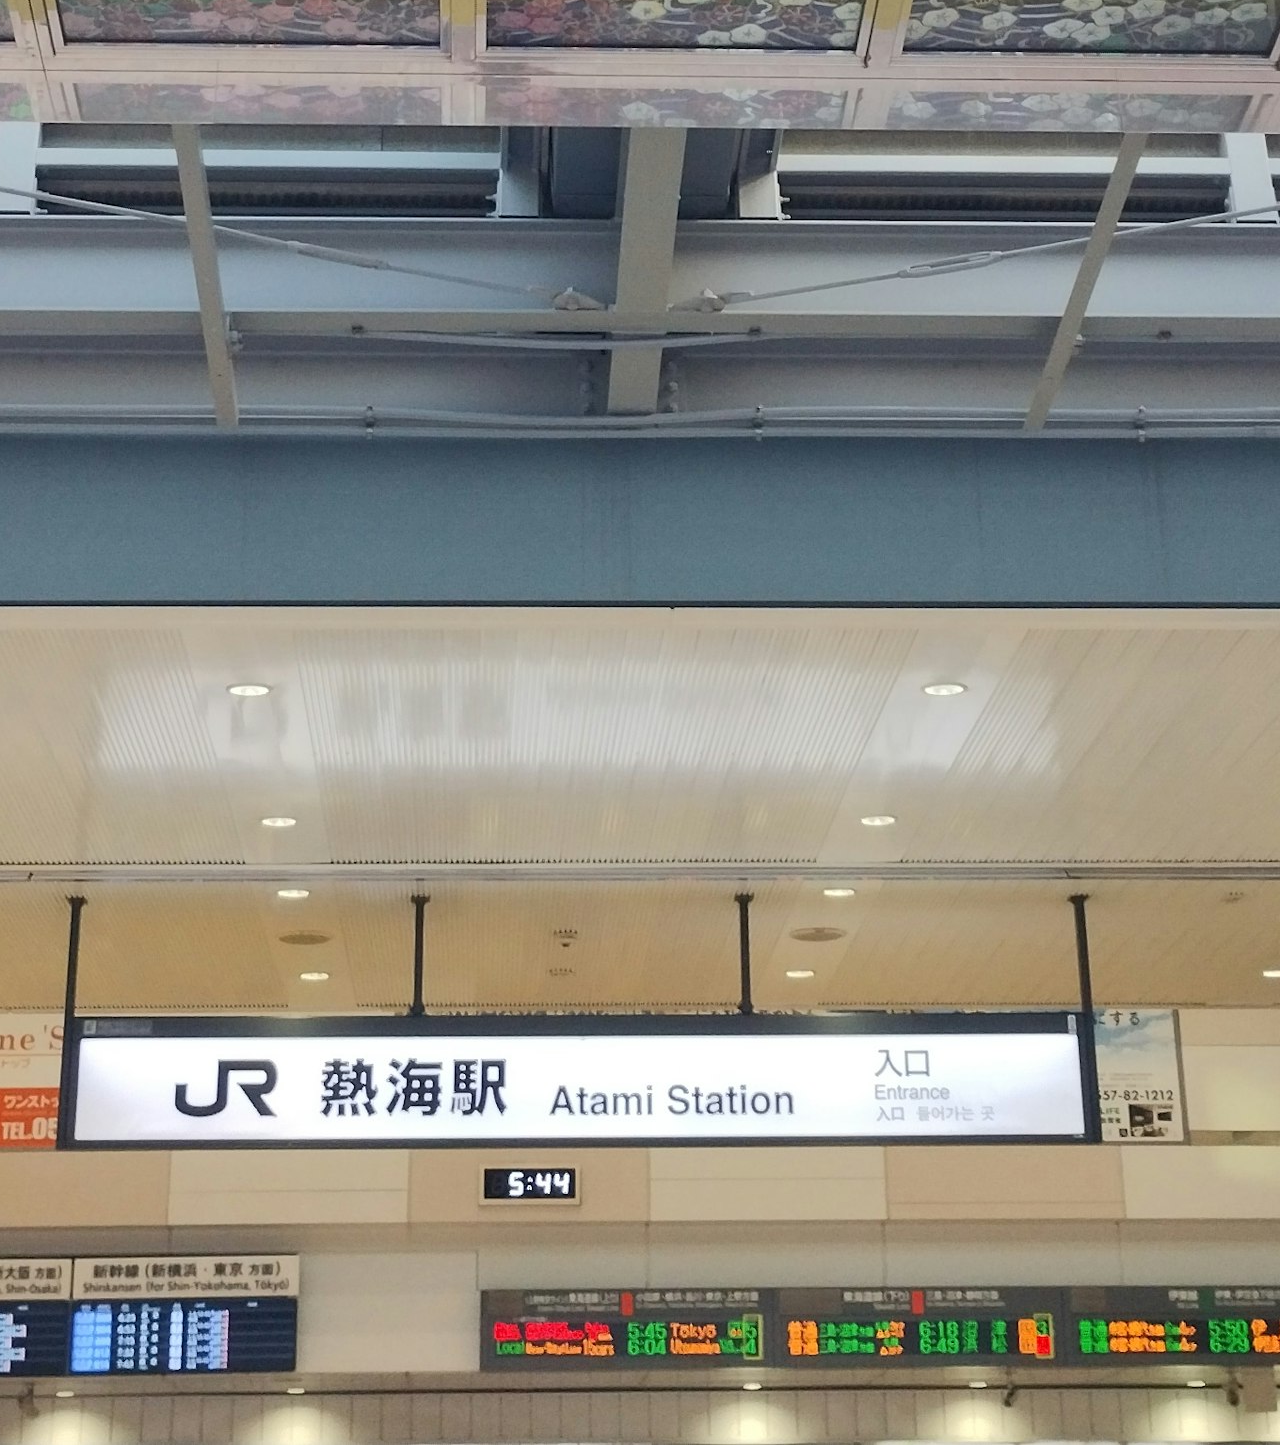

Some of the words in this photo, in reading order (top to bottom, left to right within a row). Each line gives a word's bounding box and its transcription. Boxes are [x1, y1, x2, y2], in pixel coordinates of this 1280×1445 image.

[874, 1049, 930, 1077] 入口
[174, 1059, 278, 1117] JR
[320, 1057, 507, 1117] 熱海駅
[549, 1085, 654, 1116] Atami
[666, 1085, 796, 1116] Station
[874, 1084, 951, 1101] Entrance
[1098, 1089, 1174, 1101] 57-82-1212
[876, 1106, 905, 1122] 入口
[916, 1105, 975, 1122] 들어가는
[508, 1171, 570, 1196] 5:44
[83, 1282, 141, 1294] Shinkansen
